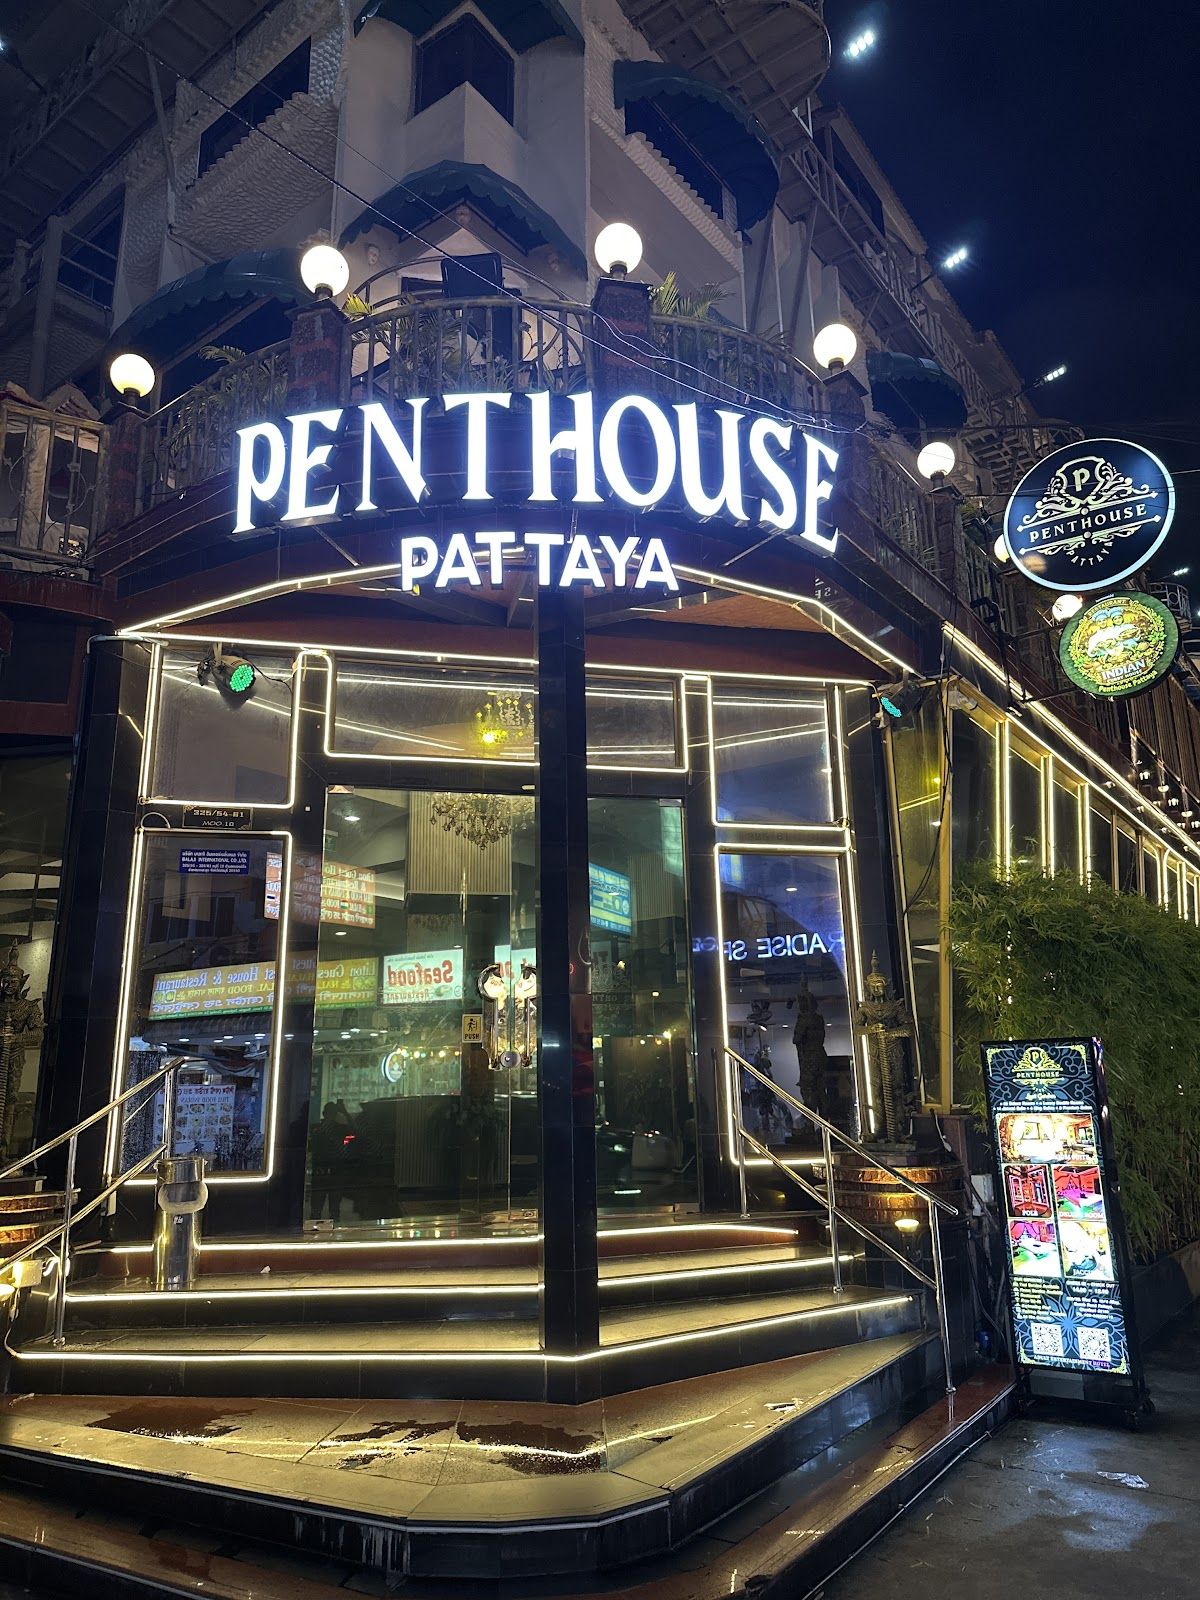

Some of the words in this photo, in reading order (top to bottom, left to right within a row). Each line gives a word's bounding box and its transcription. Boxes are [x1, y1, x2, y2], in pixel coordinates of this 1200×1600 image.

[232, 390, 839, 553] PENTHOUSE
[1029, 503, 1147, 543] PENTHOUSE
[401, 531, 680, 592] PATTAYA
[1065, 541, 1113, 567] PATTAYA
[1098, 681, 1133, 693] Penthouse
[1132, 670, 1158, 687] Pattaya
[1101, 659, 1146, 680] INDIAN
[1016, 1071, 1060, 1079] PENTHOUSE
